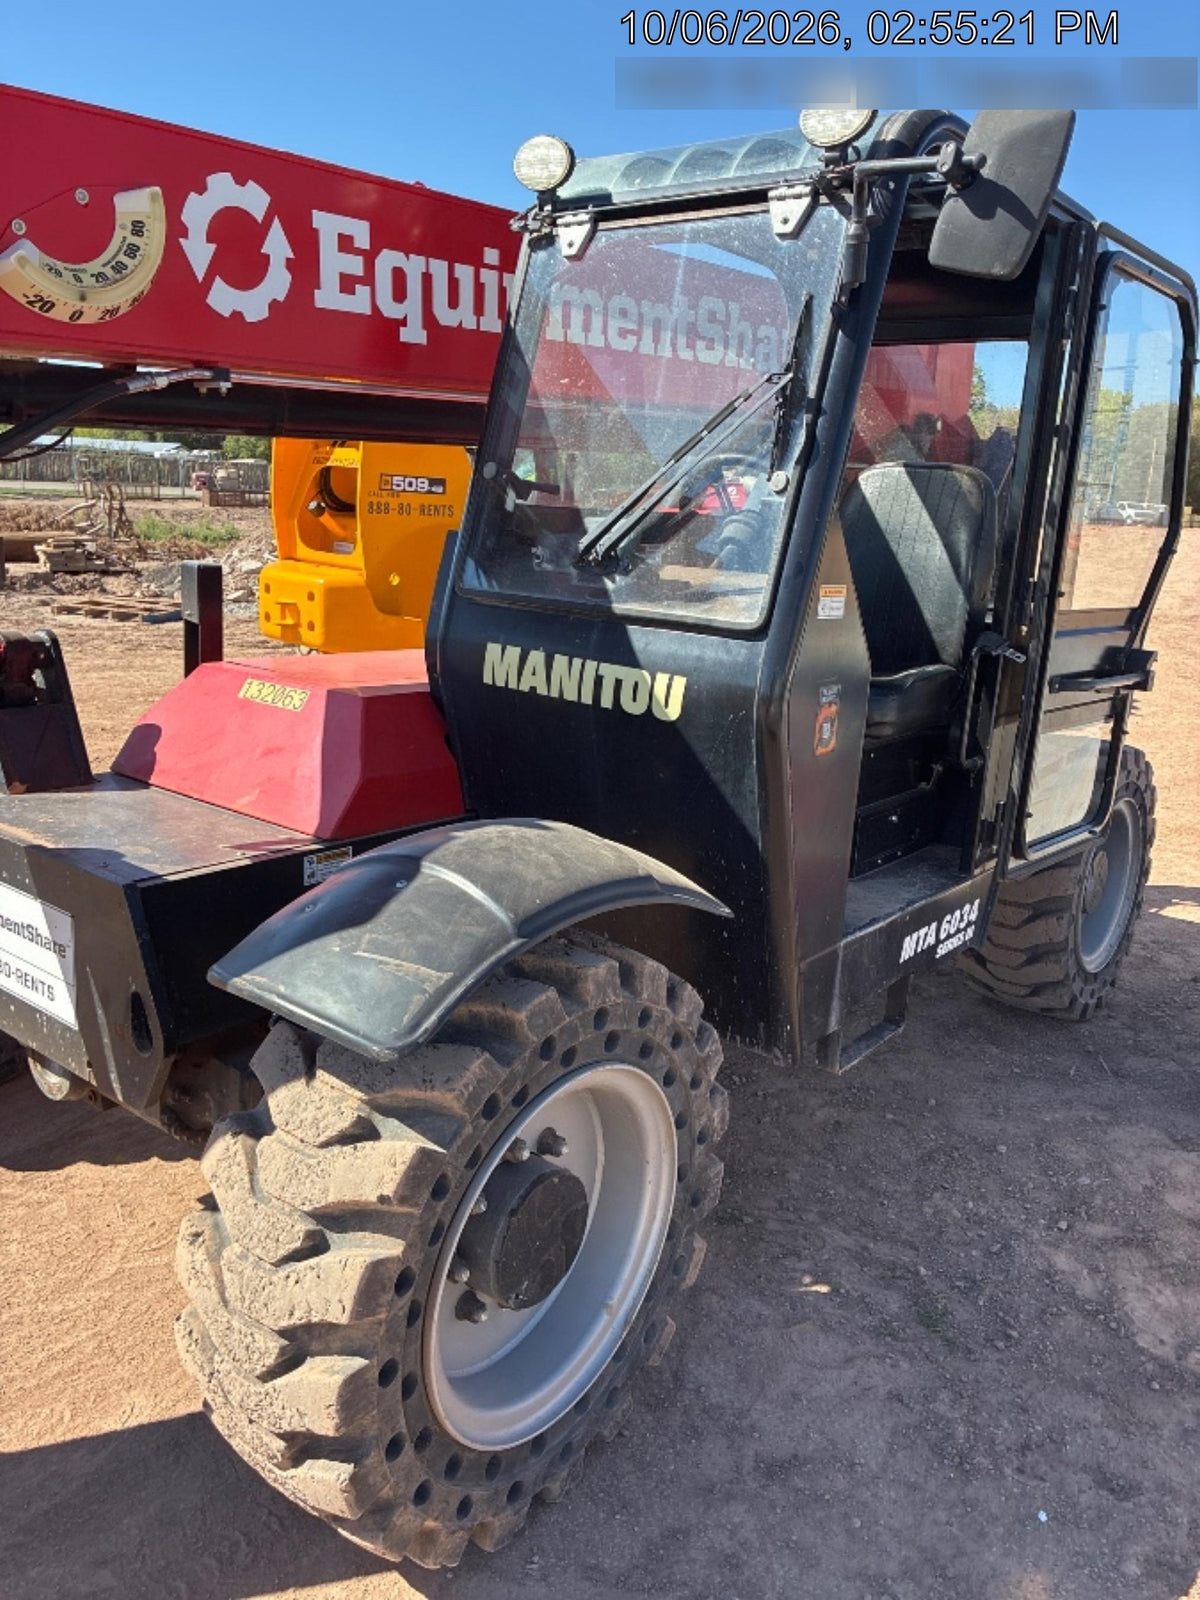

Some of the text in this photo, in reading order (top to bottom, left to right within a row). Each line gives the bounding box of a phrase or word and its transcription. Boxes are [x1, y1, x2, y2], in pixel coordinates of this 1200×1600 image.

[130, 219, 146, 238] 80
[124, 242, 141, 260] 60
[90, 271, 110, 284] 20
[110, 260, 129, 275] 40
[22, 292, 56, 314] -20
[68, 308, 84, 323] 0
[482, 641, 688, 722] MANITOU
[243, 680, 308, 710] 132063
[899, 898, 980, 964] MTA 6034
